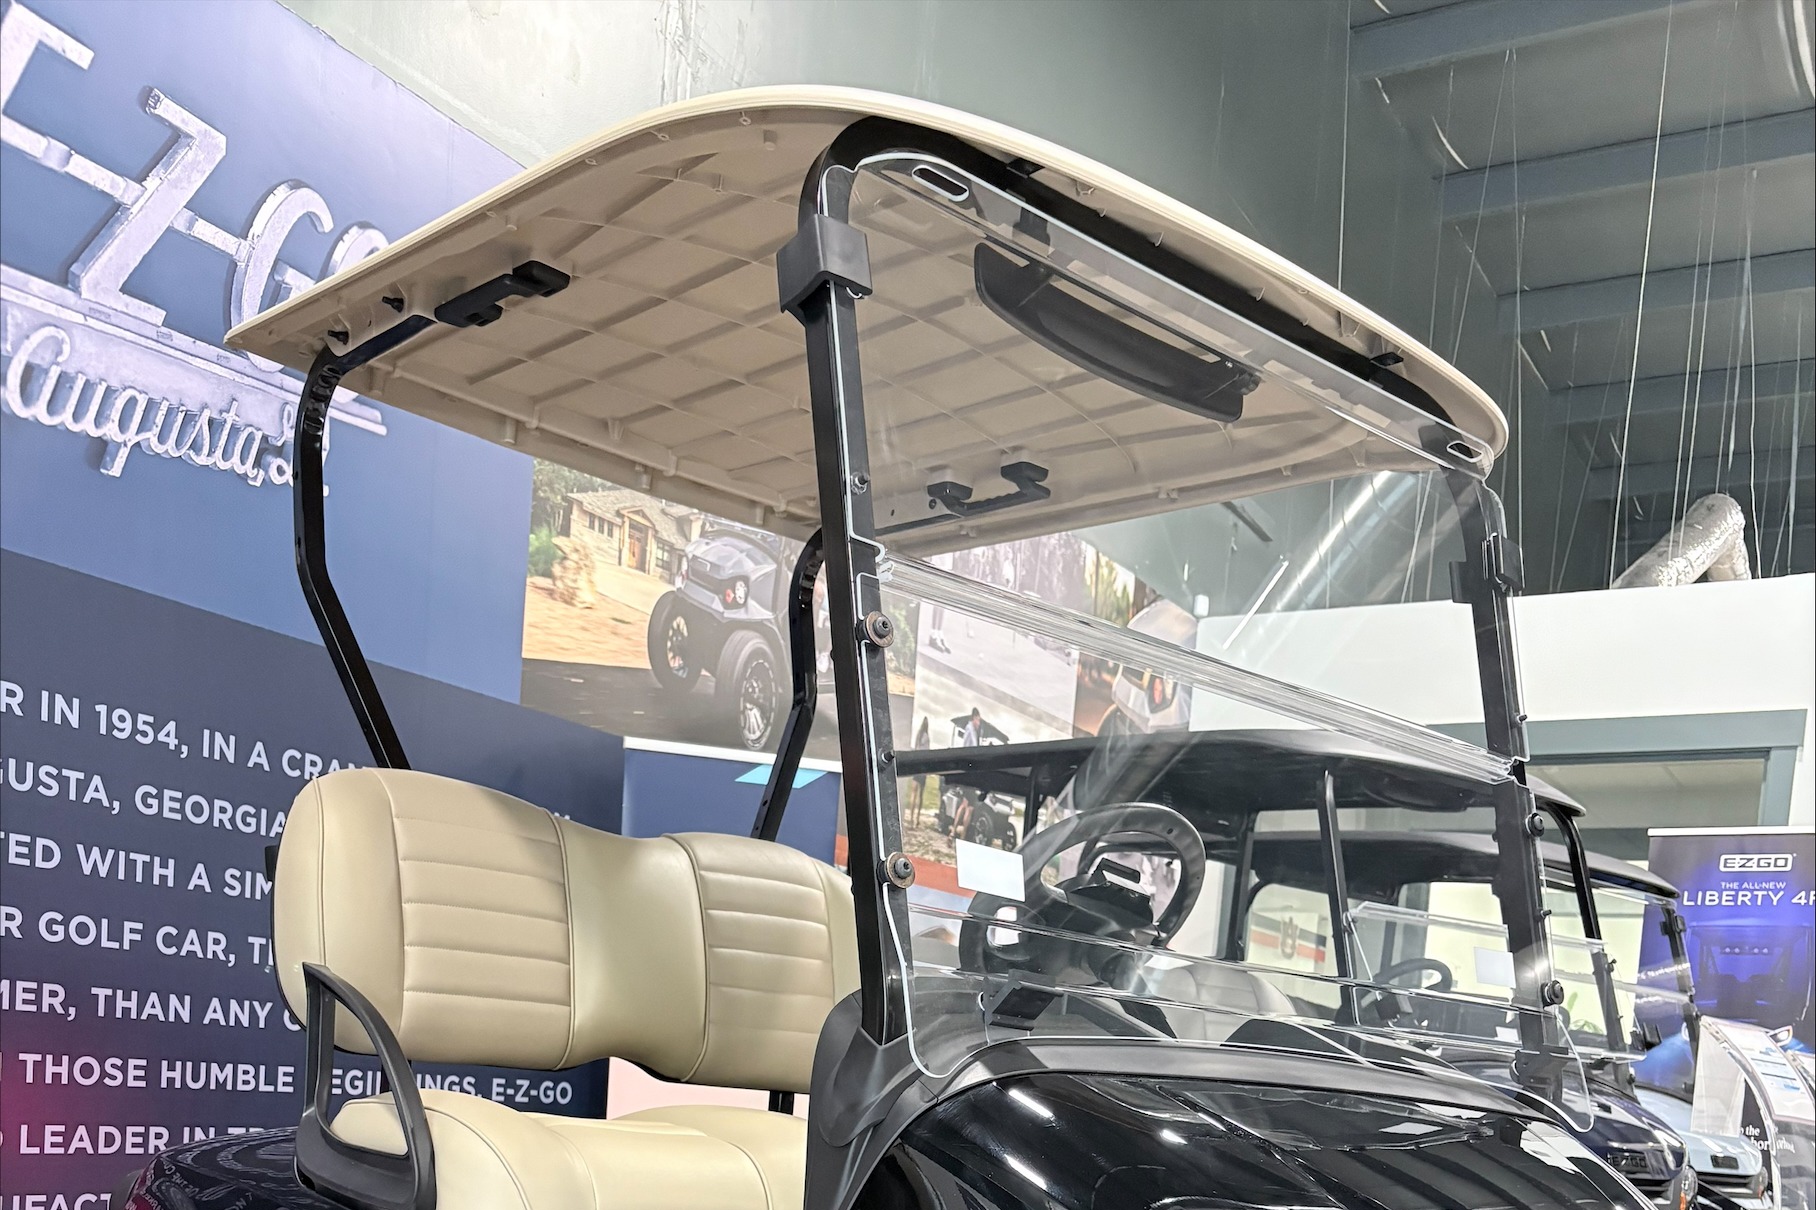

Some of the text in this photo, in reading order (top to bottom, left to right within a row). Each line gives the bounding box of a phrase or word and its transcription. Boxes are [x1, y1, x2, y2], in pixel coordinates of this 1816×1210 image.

[40, 690, 79, 729] IN
[95, 704, 188, 758] 1954,
[203, 728, 235, 763] IN
[247, 741, 270, 771] A
[0, 757, 120, 815] USTA,
[0, 831, 61, 869] ED
[76, 844, 175, 887] WITH
[187, 863, 212, 893] A
[1721, 881, 1787, 890] THE ALL-NEW
[1682, 891, 1784, 906] LIBERTY
[38, 911, 144, 950] GOLF
[155, 925, 236, 967] CAR,
[91, 987, 191, 1023] THAN
[203, 997, 273, 1028] ANY
[18, 1053, 148, 1087] THOSE
[160, 1060, 295, 1093] HUMBLE
[492, 1078, 573, 1105] E-Z-GO
[19, 1125, 169, 1155] LEADER
